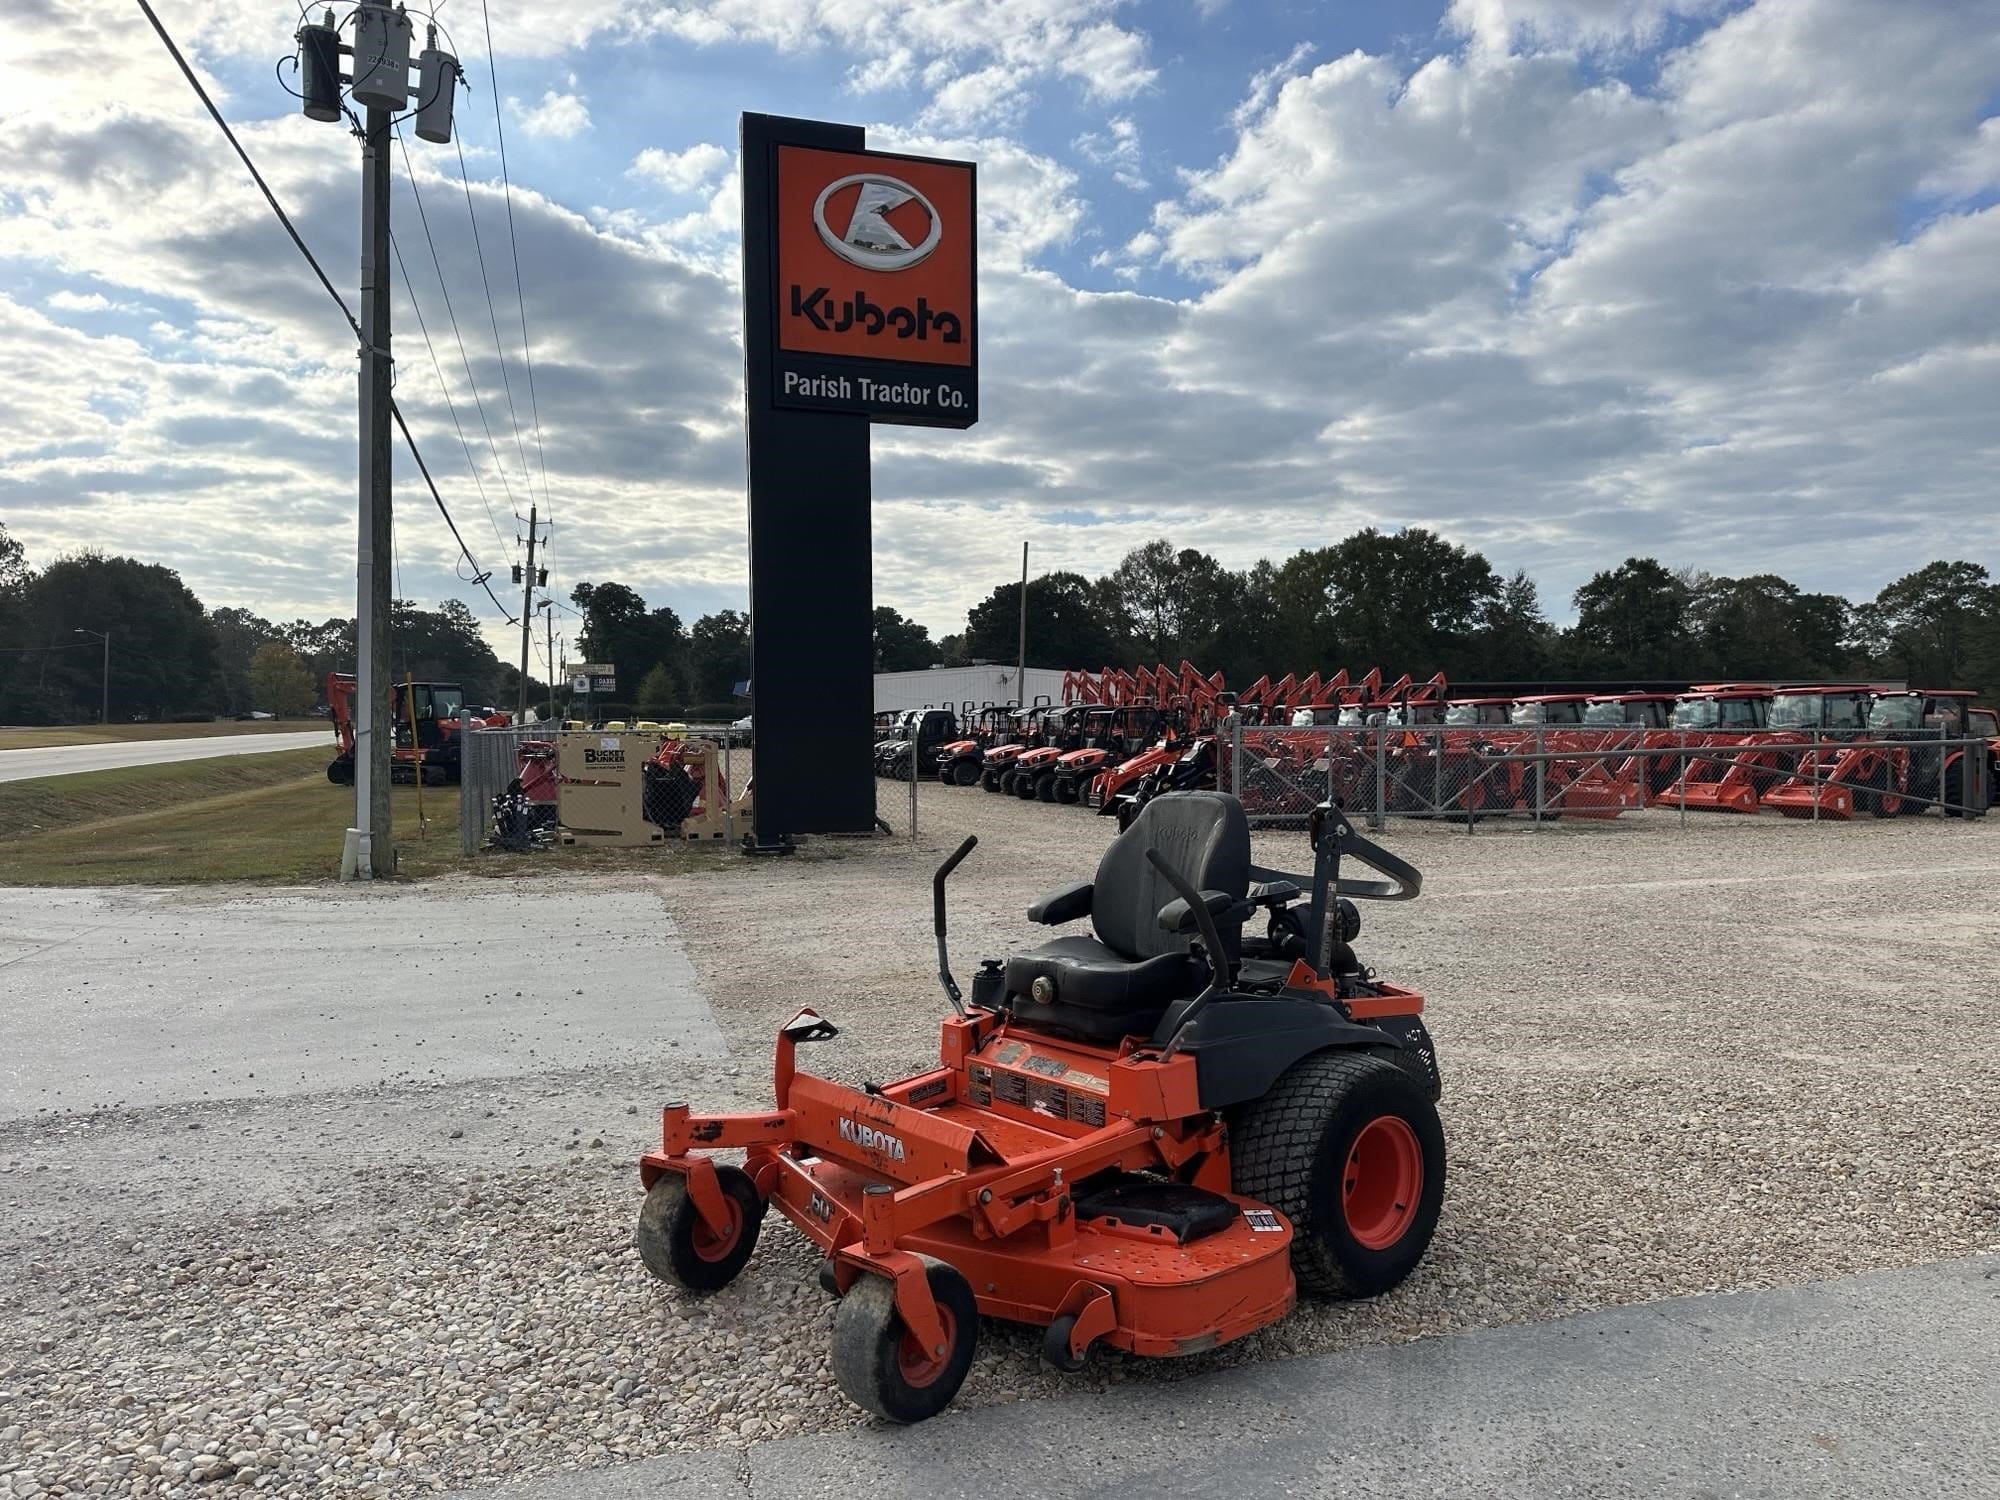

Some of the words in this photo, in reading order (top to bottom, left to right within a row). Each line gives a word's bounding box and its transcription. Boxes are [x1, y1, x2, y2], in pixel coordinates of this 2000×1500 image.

[790, 284, 962, 344] Kubota
[784, 371, 851, 399] Parish
[857, 377, 931, 405] Tractor
[937, 384, 969, 409] Co.
[1405, 1029, 1422, 1042] HOT
[839, 1116, 906, 1164] KUBOTA
